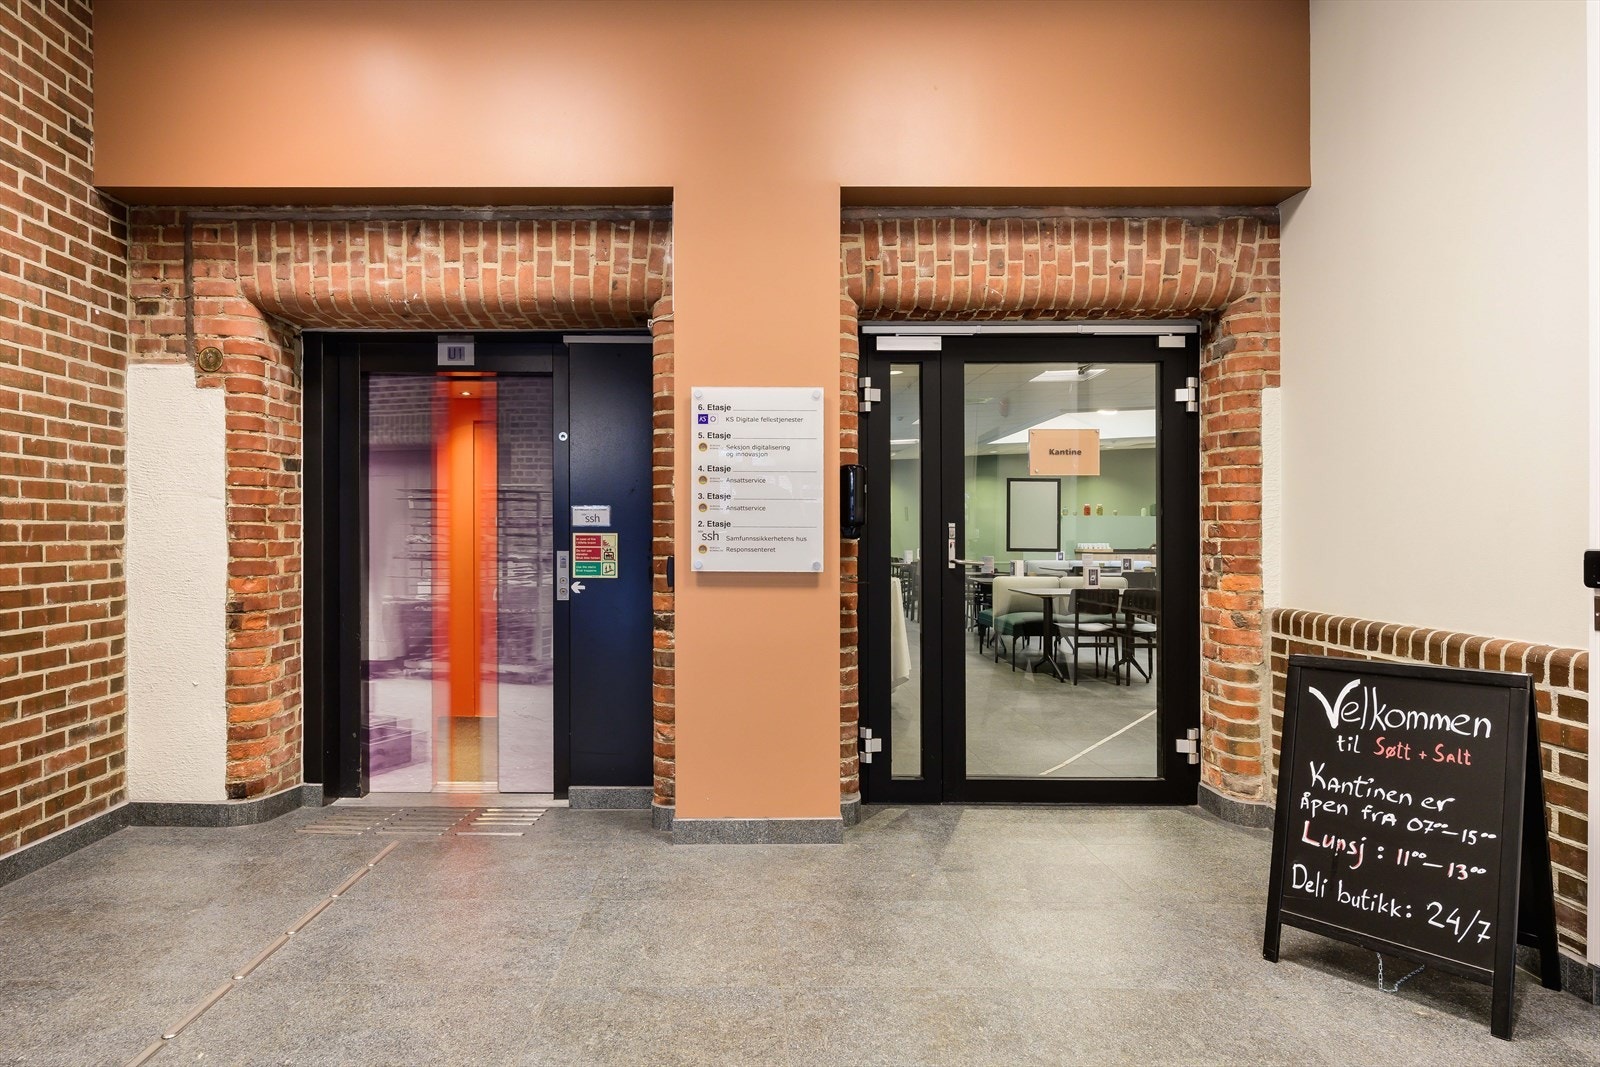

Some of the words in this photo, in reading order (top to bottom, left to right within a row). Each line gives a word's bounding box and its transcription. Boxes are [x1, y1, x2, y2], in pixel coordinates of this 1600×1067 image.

[707, 404, 732, 412] Etasje
[707, 432, 732, 440] Etasje
[1048, 448, 1082, 456] Kantine
[707, 465, 732, 474] Etasje
[707, 492, 732, 502] Etasje
[584, 514, 600, 523] ssh
[707, 520, 732, 529] Etasje
[701, 530, 720, 541] ssh
[1308, 678, 1492, 739] Velkommen
[1336, 734, 1361, 754] til
[1373, 736, 1411, 761] Søtt
[1299, 791, 1349, 818] Åpen
[1420, 796, 1456, 812] er
[1291, 863, 1328, 898] Deli
[1337, 879, 1412, 919] butikk:
[1426, 901, 1491, 944] 24/7
